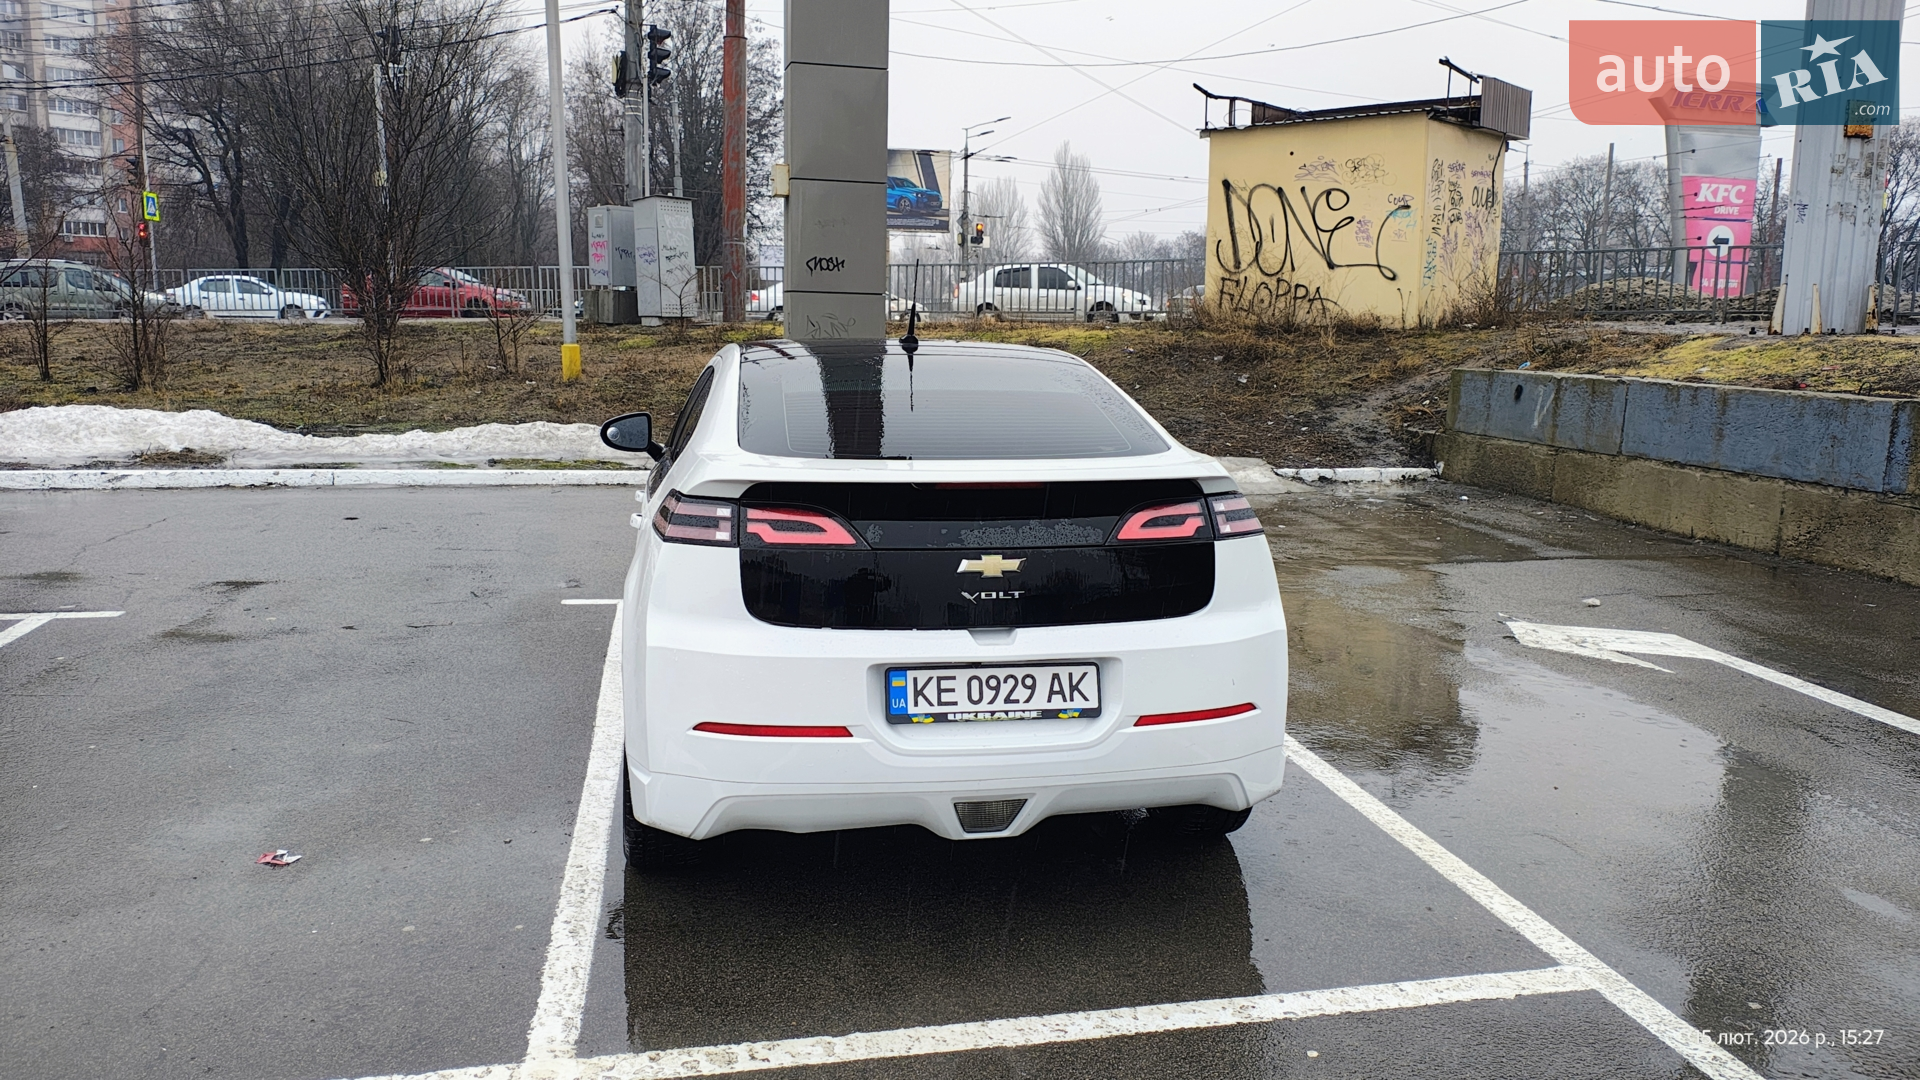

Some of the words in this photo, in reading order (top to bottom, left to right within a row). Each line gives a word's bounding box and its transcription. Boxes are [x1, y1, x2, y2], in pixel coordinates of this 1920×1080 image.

[1695, 183, 1747, 204] KFC
[1714, 206, 1740, 215] DRIVE
[1219, 276, 1330, 318] FLOPPA
[961, 591, 1026, 604] VOLT
[913, 675, 958, 707] KE
[967, 673, 1037, 706] 0929
[1047, 671, 1090, 703] AK
[892, 698, 906, 709] UA
[947, 710, 1043, 721] UKRAINE
